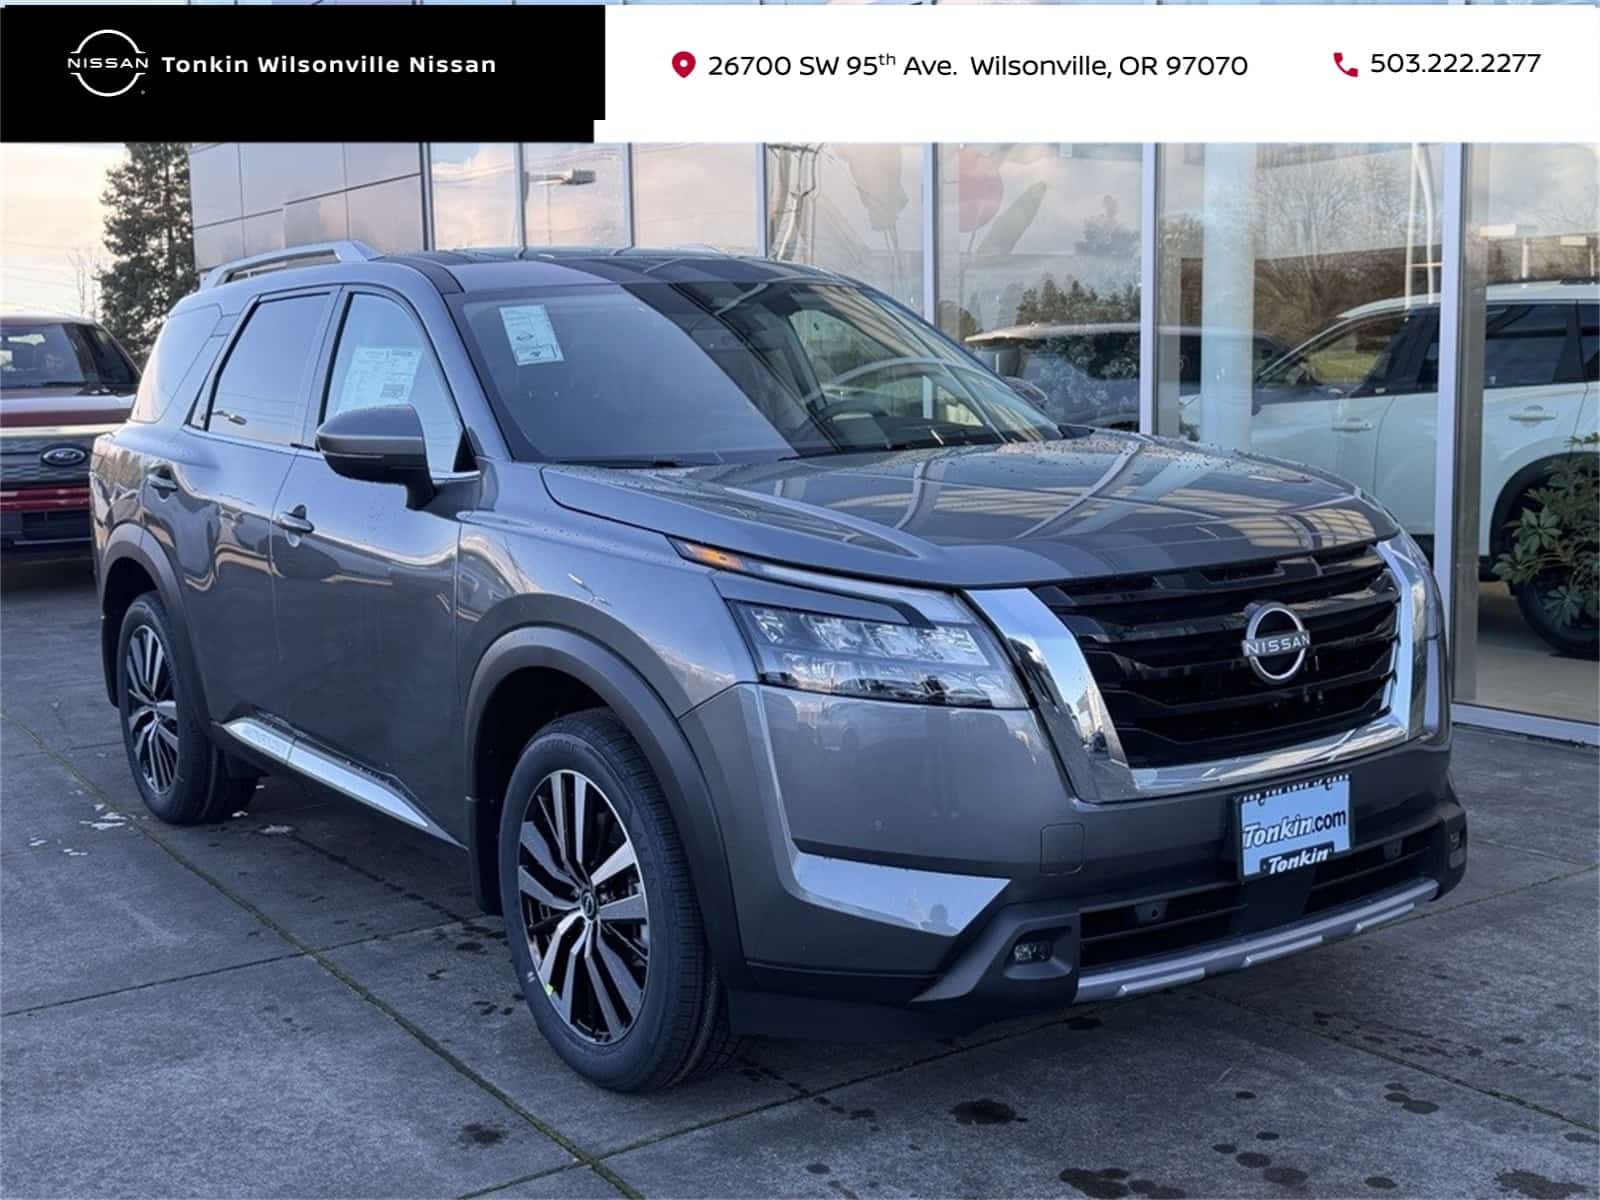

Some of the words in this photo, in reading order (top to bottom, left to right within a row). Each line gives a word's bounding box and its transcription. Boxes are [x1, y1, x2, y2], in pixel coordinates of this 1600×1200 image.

[1245, 631, 1310, 656] NISSAN
[1242, 810, 1347, 849] Tonkin.com
[1268, 847, 1330, 875] Tonkin
